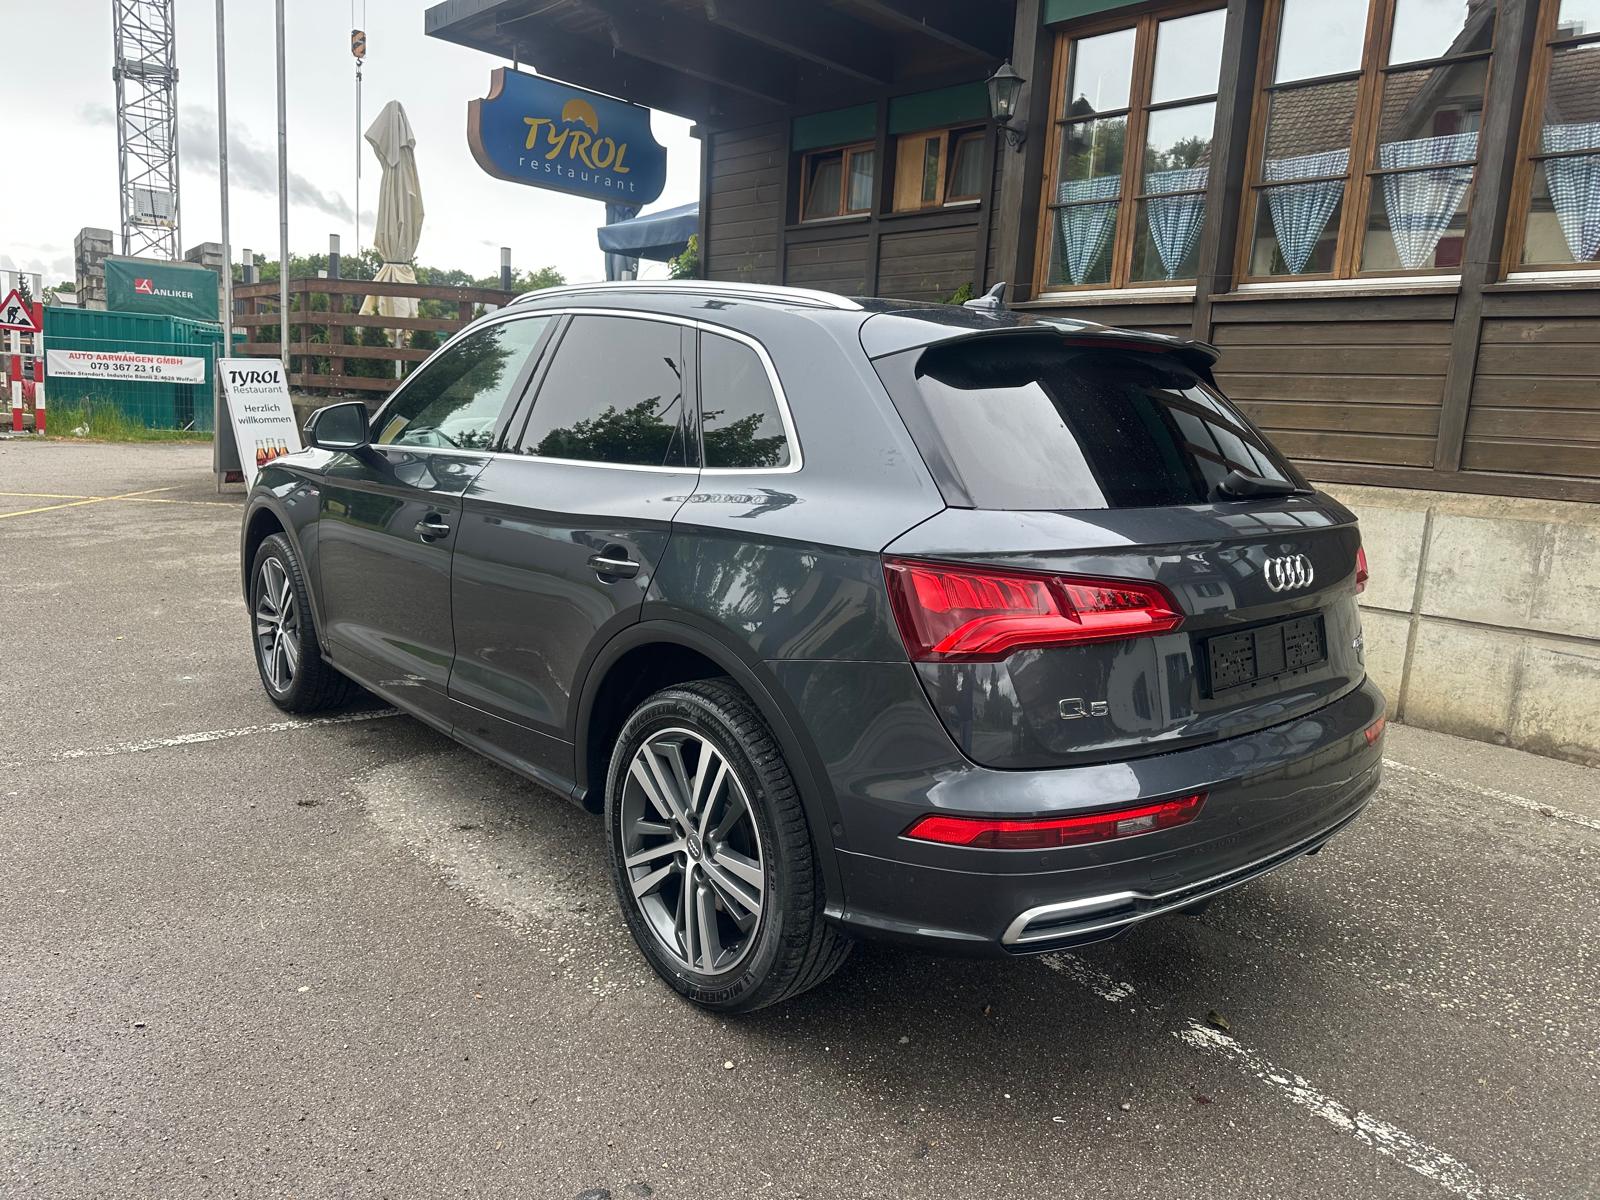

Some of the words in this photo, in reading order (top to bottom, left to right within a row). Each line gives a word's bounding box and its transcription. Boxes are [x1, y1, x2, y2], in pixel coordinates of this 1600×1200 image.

[523, 116, 630, 174] TYROL
[519, 156, 635, 192] restaurant
[153, 288, 193, 299] ANLIKER
[68, 352, 93, 360] AUTO
[96, 353, 154, 364] AARWANGEN
[156, 357, 183, 366] GMBH
[90, 362, 109, 370] 079
[113, 363, 132, 372] 367
[134, 364, 146, 372] 23
[149, 365, 162, 373] 16
[229, 370, 281, 387] TYROL
[233, 385, 283, 394] Restaurant
[244, 404, 281, 413] Herzlich
[238, 416, 292, 425] willkommen
